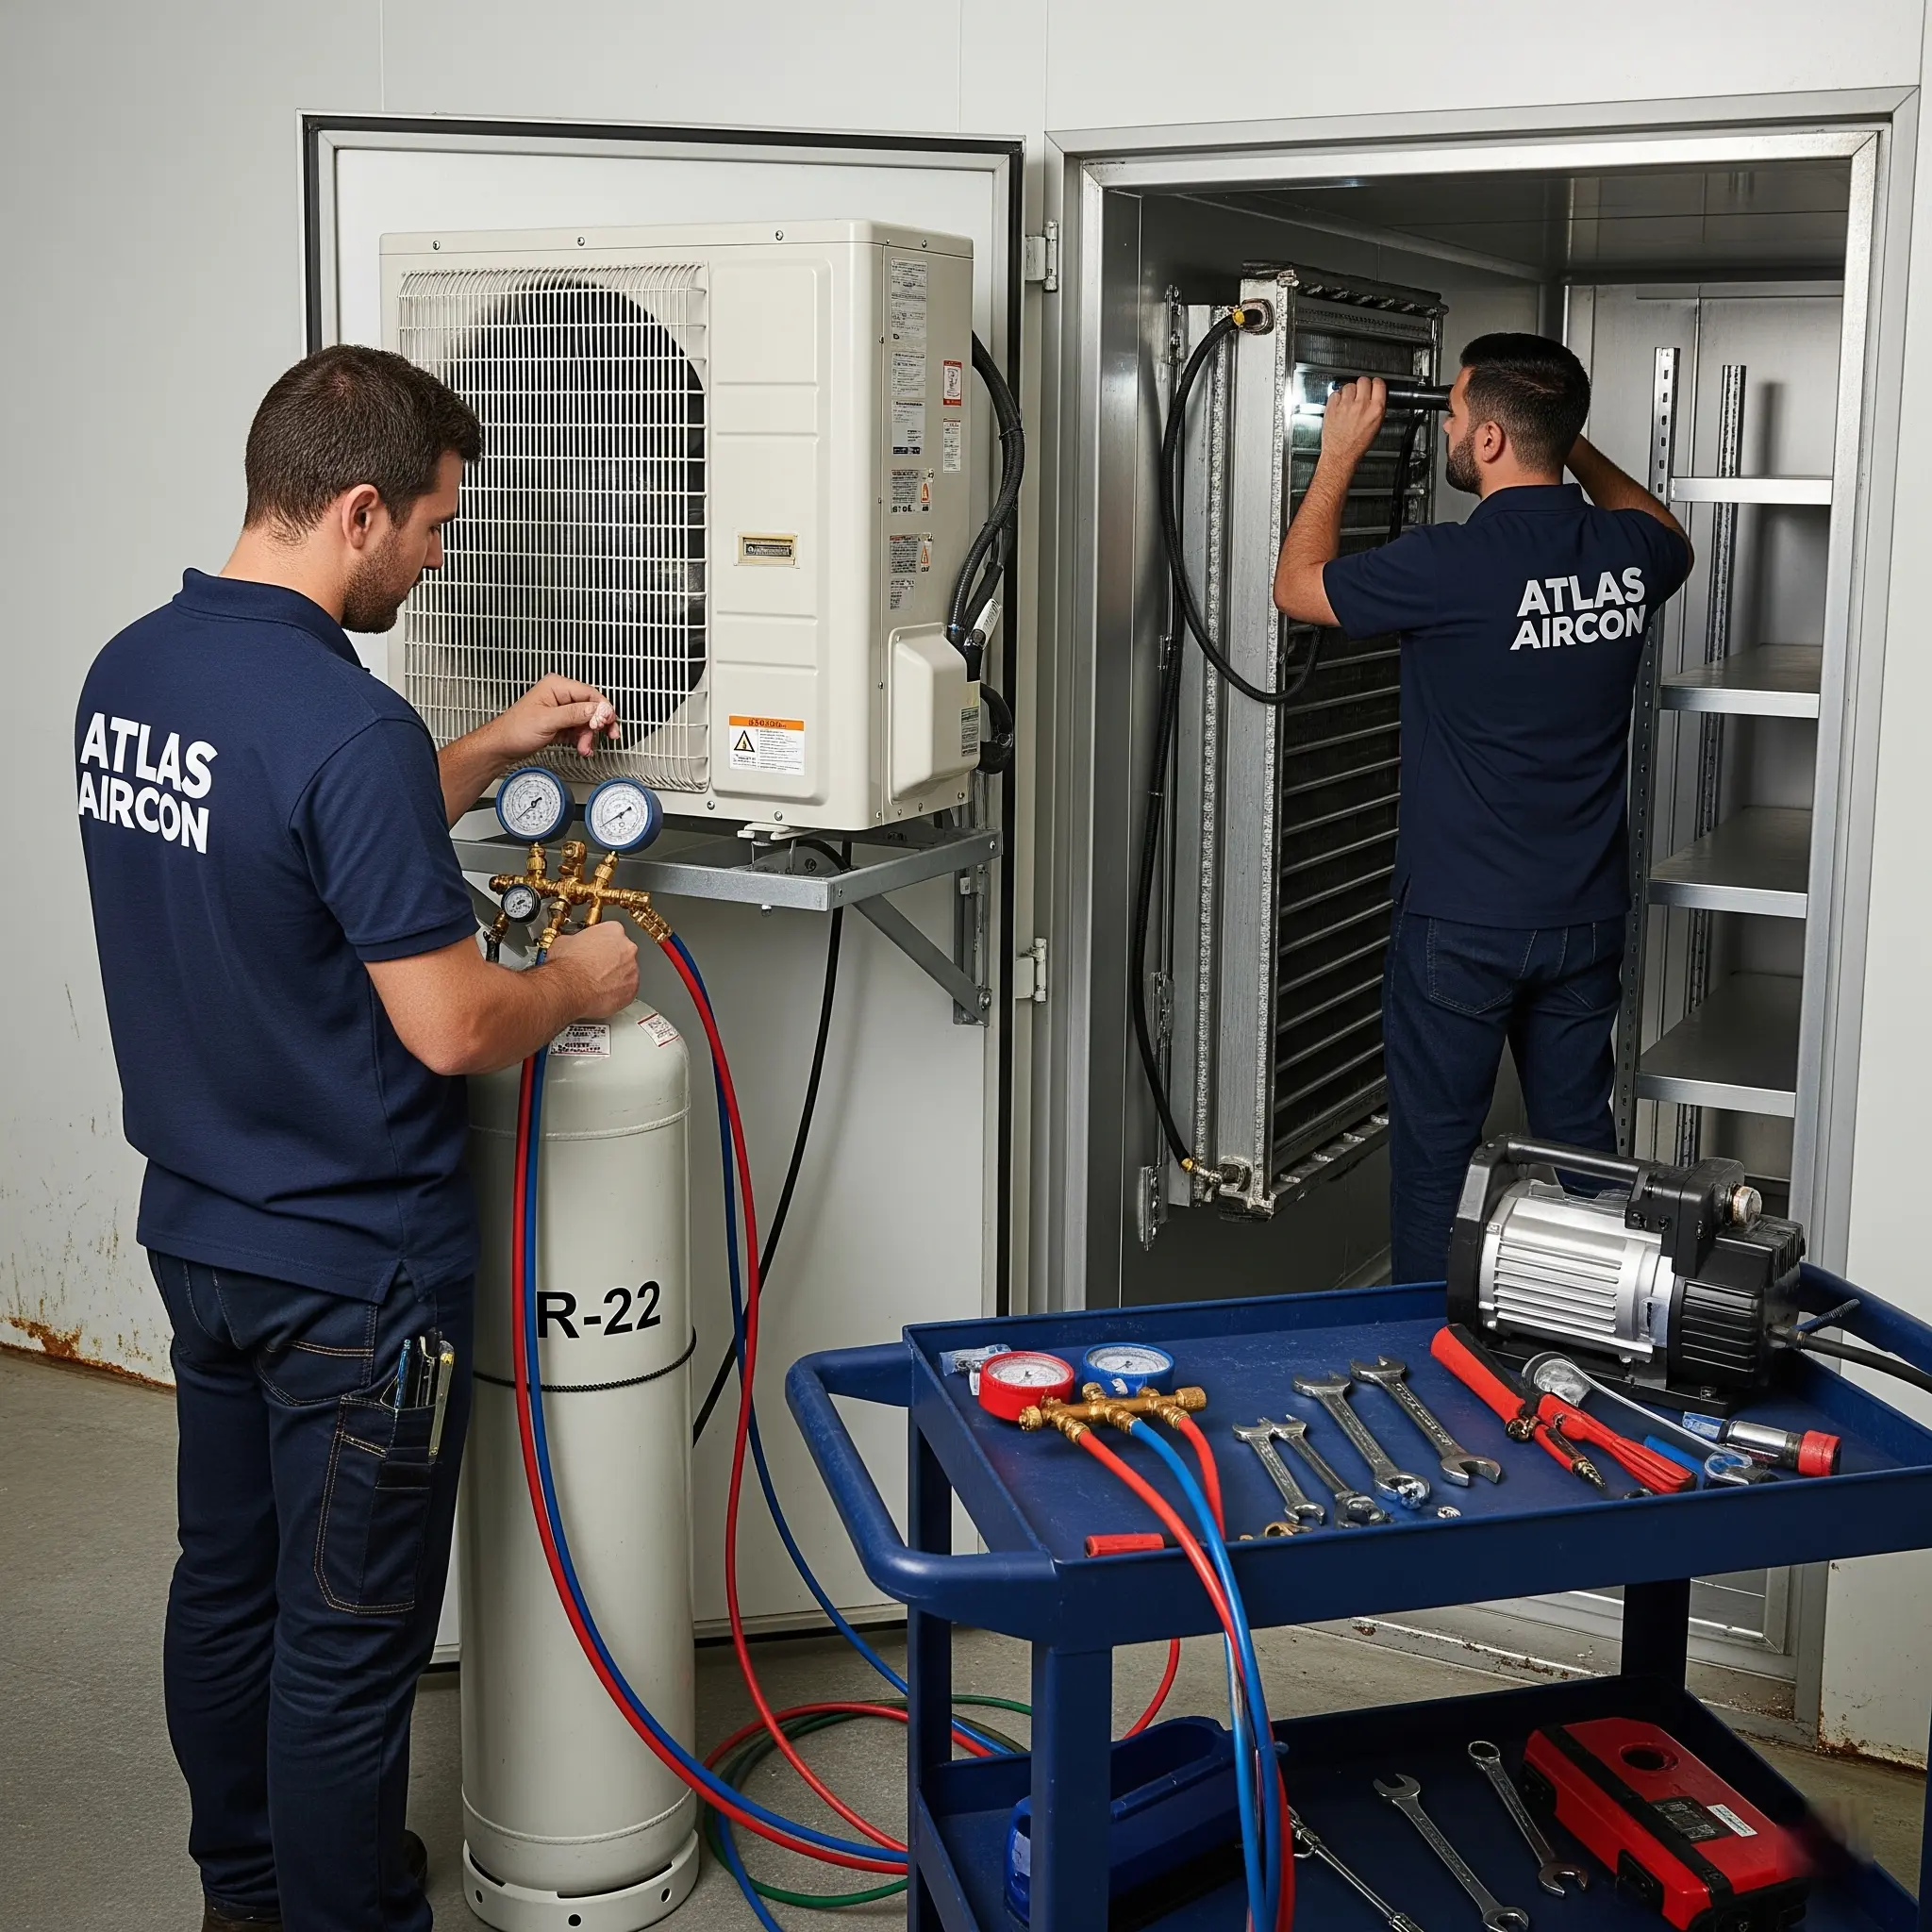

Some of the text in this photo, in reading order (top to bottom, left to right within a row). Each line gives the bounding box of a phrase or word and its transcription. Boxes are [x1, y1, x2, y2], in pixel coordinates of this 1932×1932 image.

[1516, 567, 1645, 617] ATLAS
[1509, 605, 1646, 650] AIRCON
[80, 712, 218, 799] ATLAS
[78, 771, 209, 854] AIRCON
[536, 1280, 661, 1339] R-22
